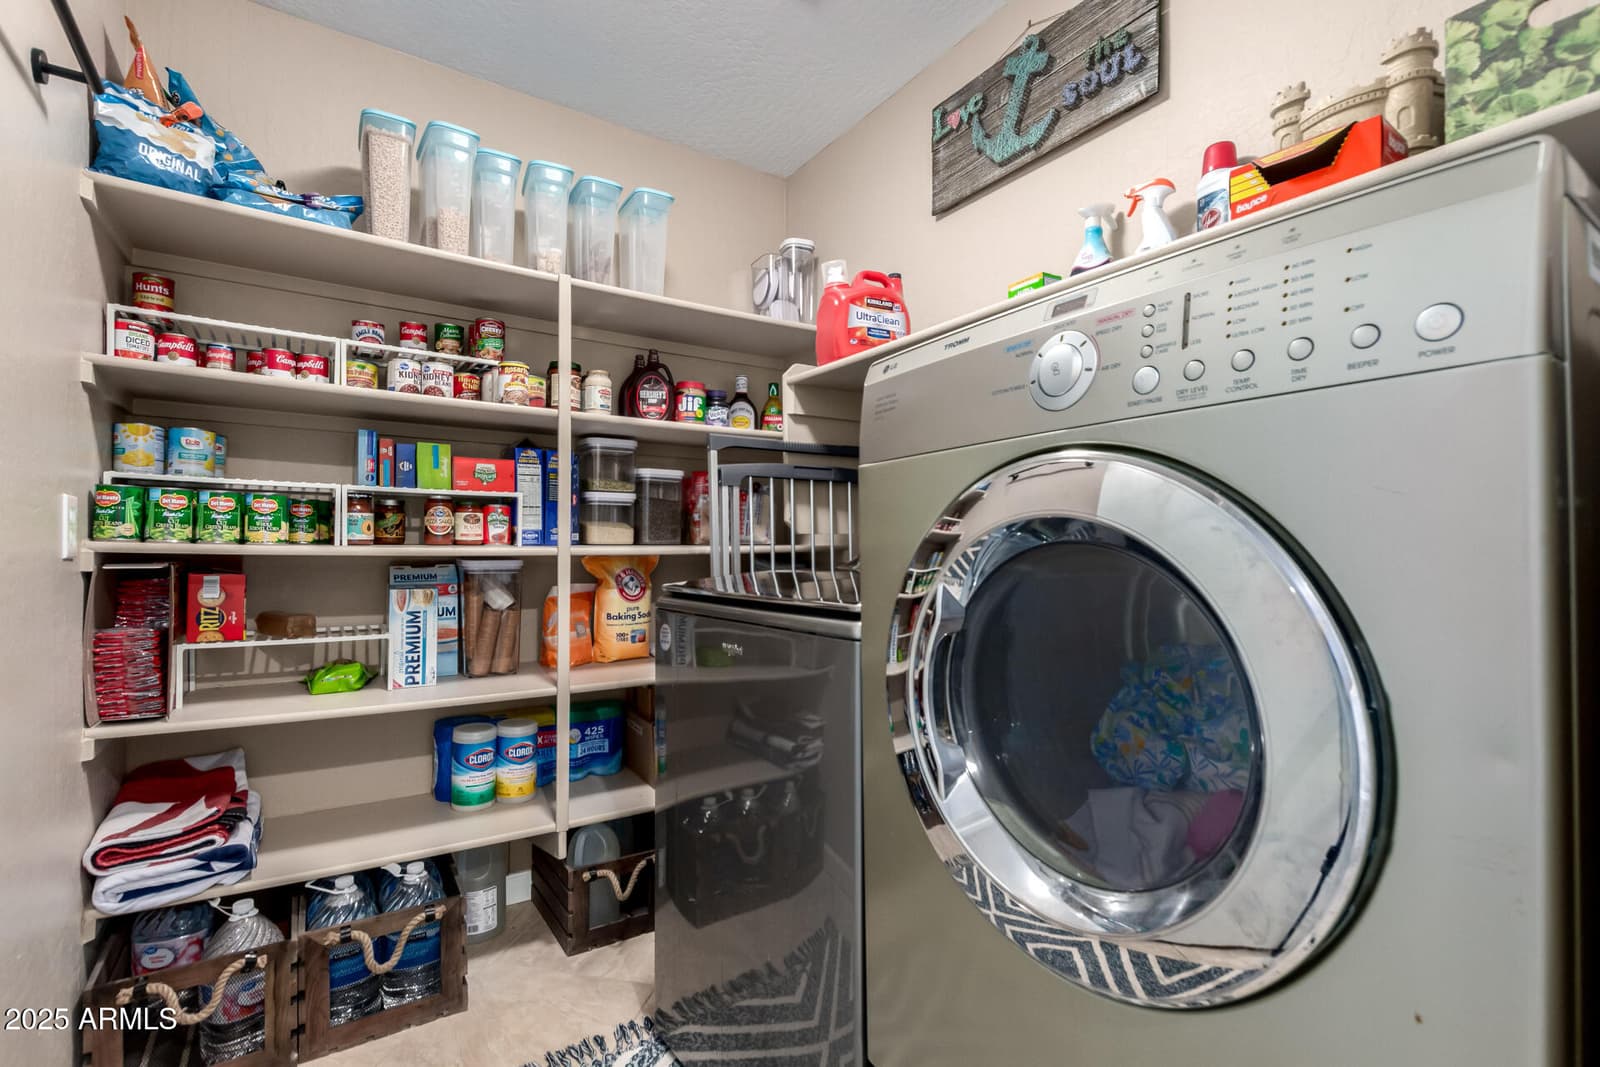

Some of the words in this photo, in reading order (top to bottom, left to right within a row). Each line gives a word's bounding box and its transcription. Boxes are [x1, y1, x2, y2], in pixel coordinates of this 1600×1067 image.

[138, 142, 201, 182] ORIGINAL
[856, 311, 900, 327] UltraClean
[125, 336, 151, 346] DICED
[1418, 346, 1456, 359] POWER
[1347, 359, 1380, 370] BEEPER
[393, 573, 438, 581] PREMIUM
[626, 606, 640, 614] pure
[199, 607, 220, 631] RITZ
[606, 611, 637, 621] Baking
[404, 611, 422, 686] PREMIUM
[584, 725, 605, 735] 425
[508, 746, 534, 757] CLOROX
